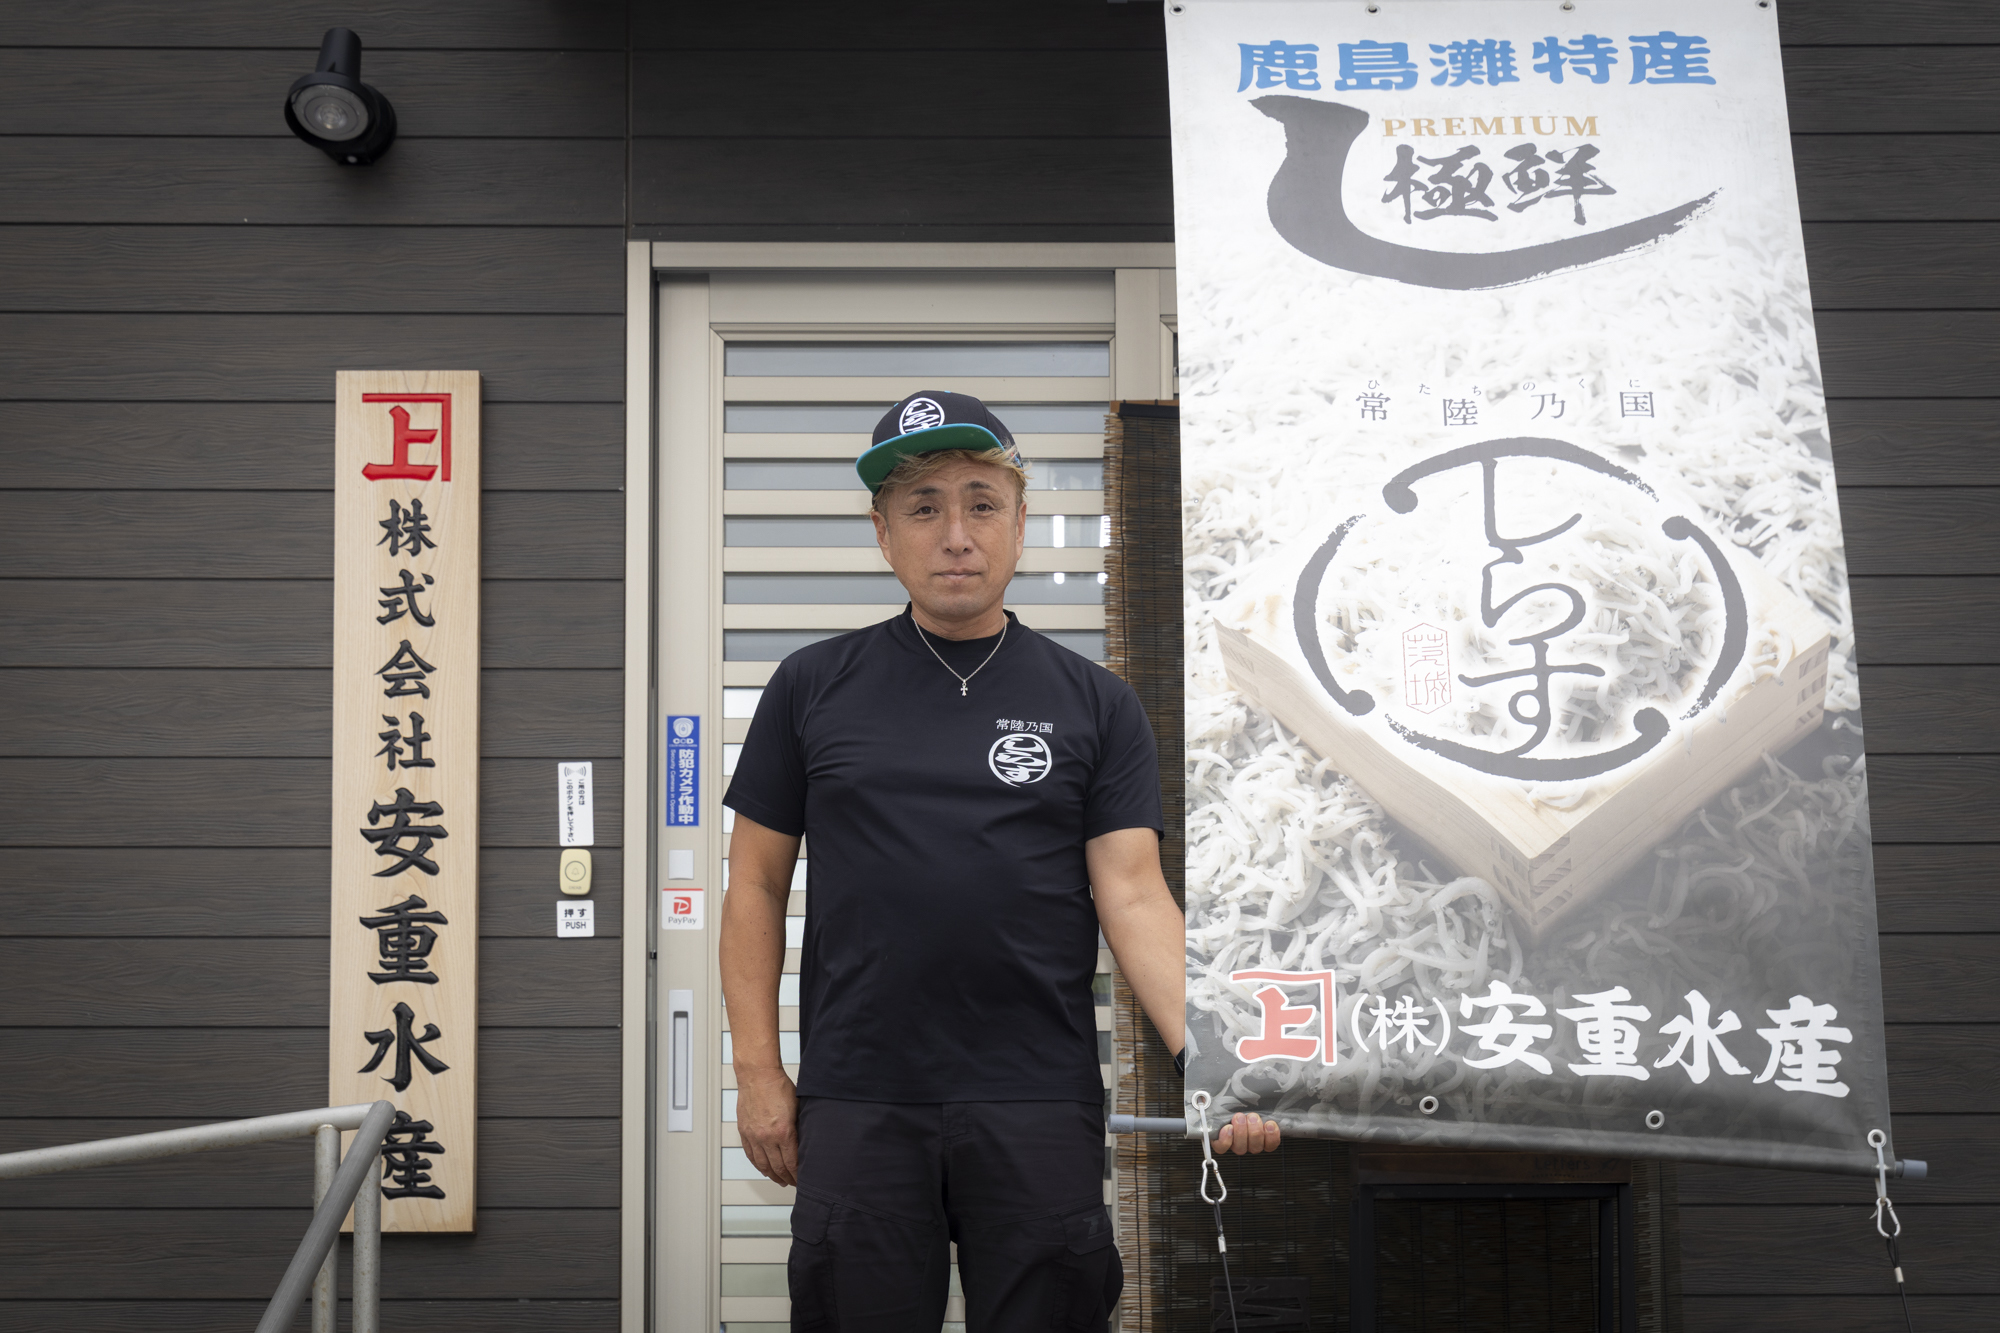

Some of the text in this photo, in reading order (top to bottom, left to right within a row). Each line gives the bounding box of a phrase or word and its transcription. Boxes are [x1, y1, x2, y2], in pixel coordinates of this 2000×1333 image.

[1236, 31, 1717, 92] 鹿島灘特産
[1382, 116, 1601, 137] PREMIUM
[1381, 143, 1617, 226] 極鮮
[1355, 391, 1656, 427] 常陸乃国
[996, 718, 1053, 733] 常陸乃国
[678, 749, 695, 824] 防犯カメラ作動中
[564, 908, 587, 917] 押す
[668, 916, 697, 925] PayPay
[565, 921, 587, 929] PUSH
